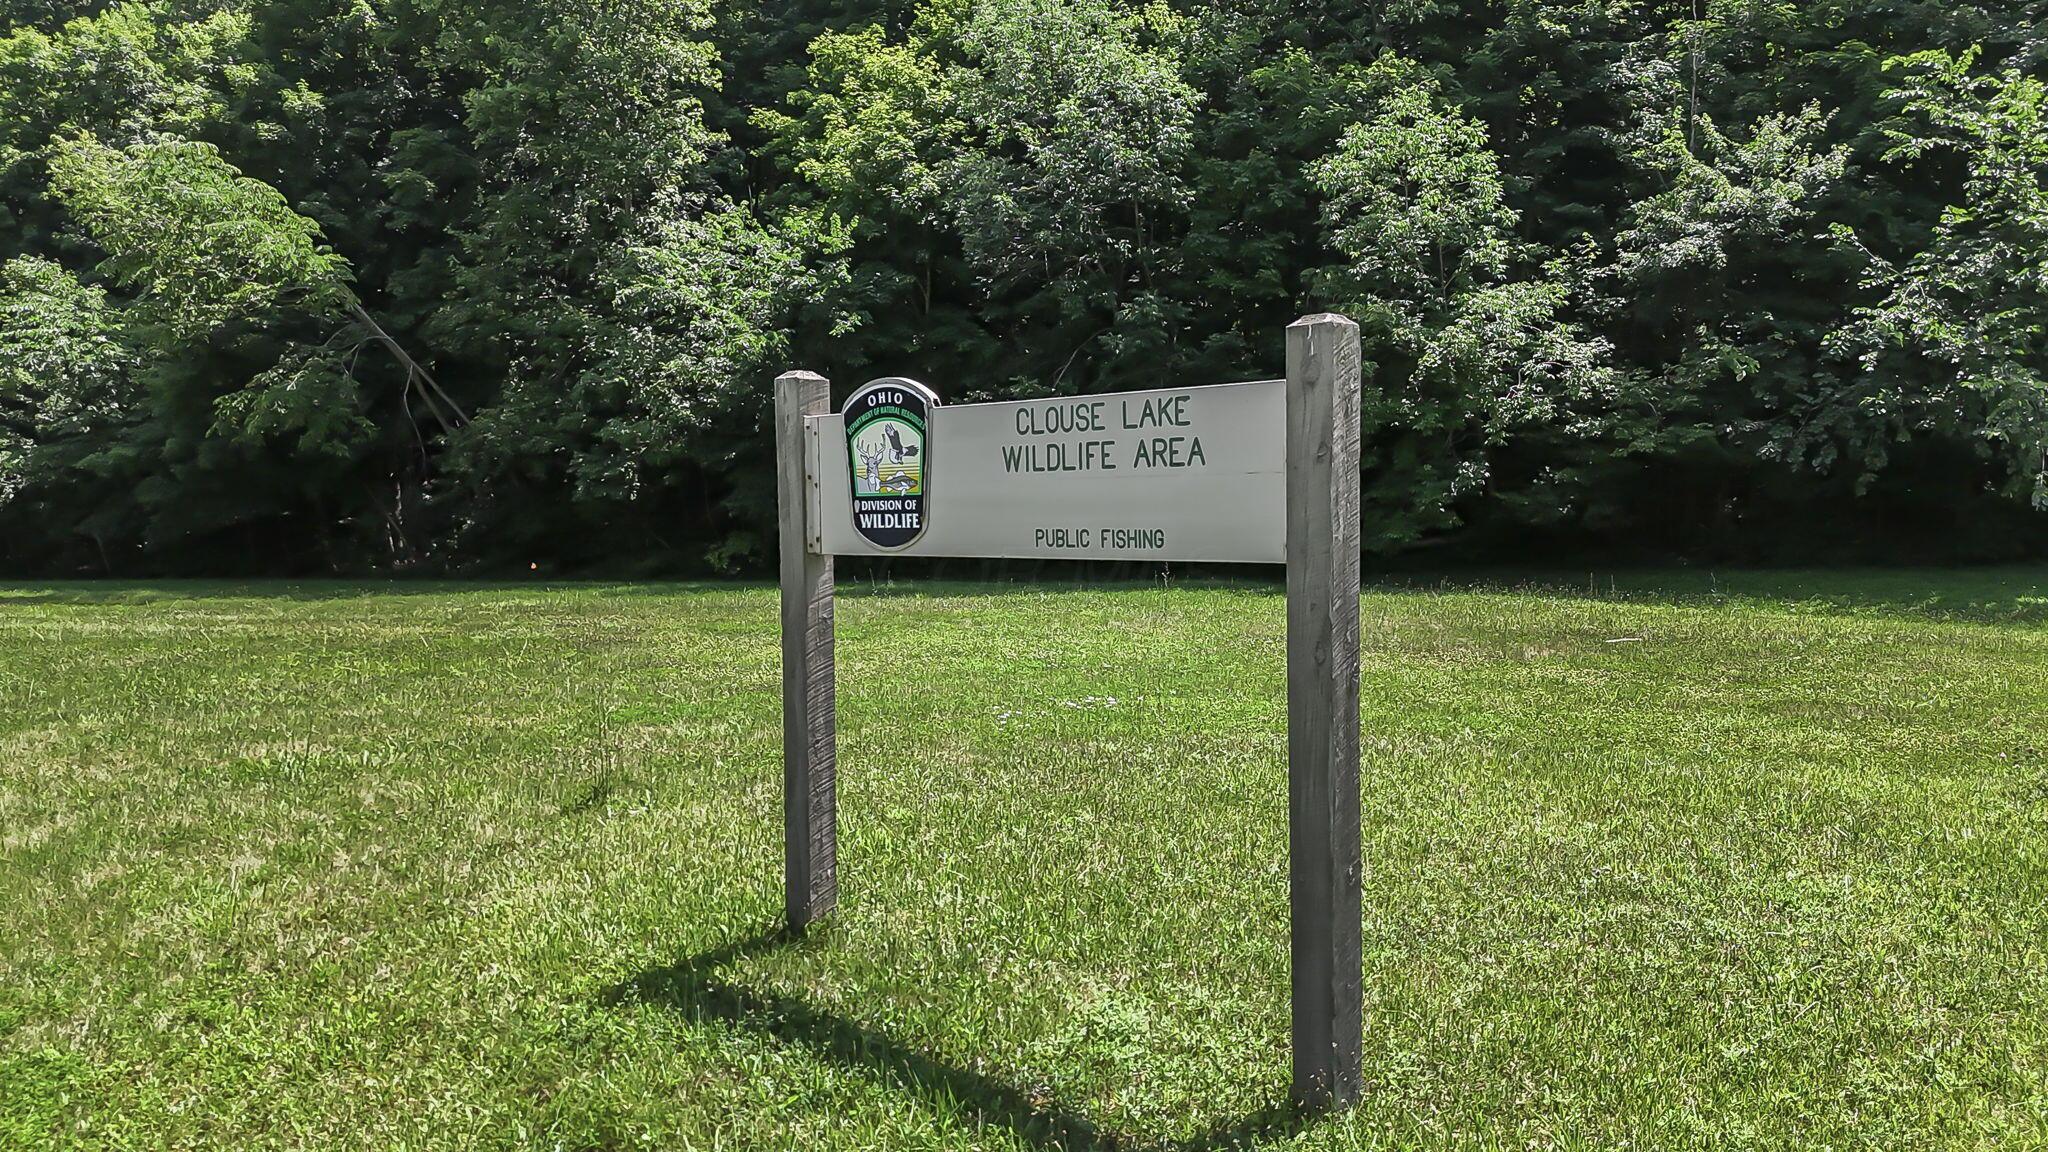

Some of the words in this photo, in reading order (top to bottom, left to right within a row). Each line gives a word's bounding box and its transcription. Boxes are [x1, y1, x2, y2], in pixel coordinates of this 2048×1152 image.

[867, 391, 903, 407] OHIO
[847, 411, 874, 435] DEPARTMENT
[873, 407, 880, 416] OF
[880, 405, 900, 415] NATURAL
[1016, 401, 1106, 436] CLOUSE
[1122, 395, 1191, 430] LAKE
[1002, 440, 1116, 473] WILDLIFE
[1133, 436, 1206, 468] AREA
[861, 500, 902, 511] DIVISION
[904, 499, 917, 511] OF
[859, 513, 920, 529] WILDLIFE
[1035, 528, 1090, 549] PUBLIC
[1100, 528, 1165, 549] FISHING
